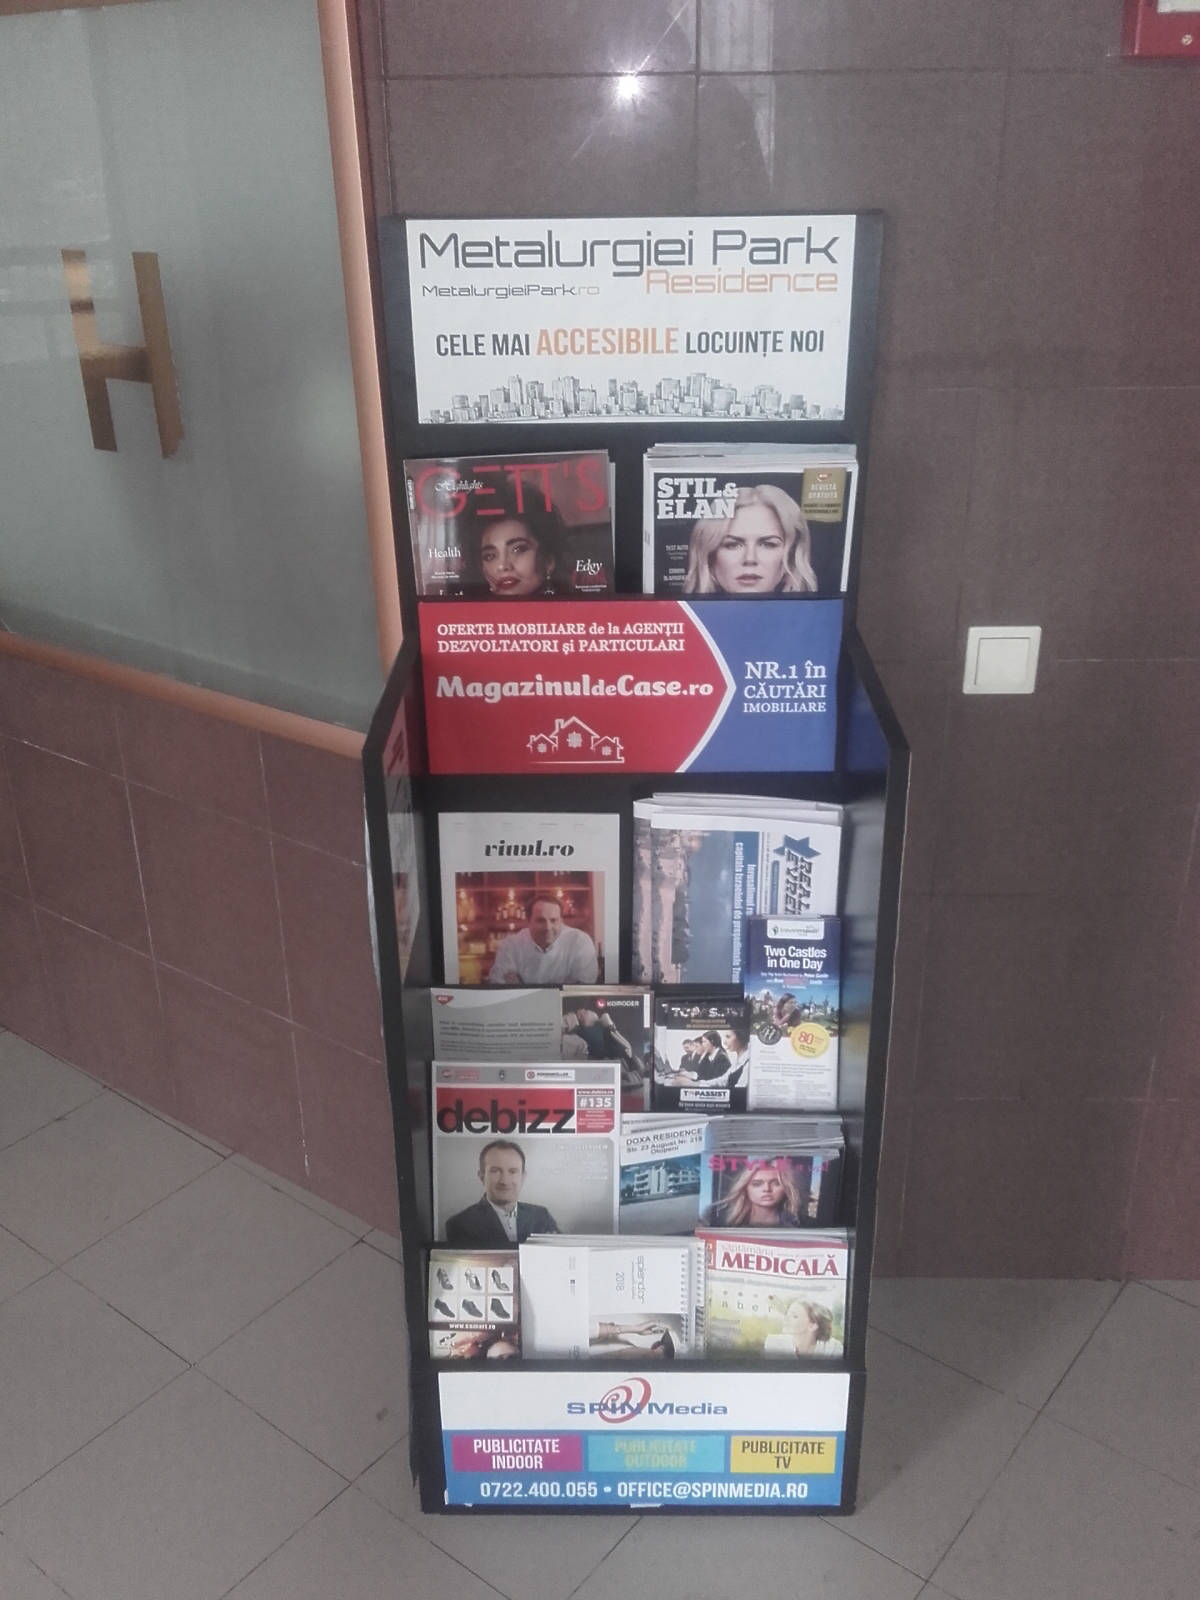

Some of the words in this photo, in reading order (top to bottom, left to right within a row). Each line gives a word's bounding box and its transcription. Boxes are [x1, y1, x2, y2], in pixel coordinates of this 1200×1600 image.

[418, 229, 694, 277] Metalurgiei
[711, 226, 840, 265] Park
[645, 267, 839, 295] Residence
[422, 283, 600, 299] MetalurgieiPark.ro
[435, 334, 486, 357] CELE
[491, 333, 531, 356] MAI
[535, 327, 679, 356] ACCESIBILE
[685, 329, 784, 357] LOCUINȚE
[790, 329, 825, 352] NOI
[416, 458, 605, 518] GETT'S
[656, 499, 737, 519] ELAN
[428, 546, 461, 559] Health
[575, 558, 603, 575] Edgy
[437, 623, 495, 635] OFERTE
[498, 623, 586, 635] IMOBILIARE
[589, 622, 605, 635] de
[608, 622, 620, 635] la
[437, 640, 559, 652] DEZVOLTATORI
[578, 639, 685, 652] PARTICULARI
[744, 661, 798, 679] NR.1
[805, 660, 826, 678] în
[436, 674, 713, 703] MagazinuldeCase.ro
[744, 681, 826, 699] CĂUTĂRI
[744, 702, 827, 712] IMOBILIARE
[764, 945, 786, 957] Two
[788, 946, 827, 958] Castles
[767, 957, 778, 968] in
[780, 958, 800, 969] One
[803, 959, 824, 971] Day
[798, 1031, 814, 1045] 80
[580, 1097, 612, 1108] #135
[436, 1099, 575, 1133] debizz
[626, 1134, 651, 1146] DOXA
[652, 1128, 703, 1141] RESIDENCE
[650, 1139, 676, 1150] August
[721, 1252, 839, 1276] MEDICALĂ
[648, 1402, 728, 1415] Media
[473, 1439, 560, 1454] PUBLICITATE
[741, 1441, 825, 1455] PUBLICITATE
[491, 1455, 543, 1469] INDOOR
[774, 1455, 792, 1469] TV
[480, 1481, 598, 1498] 0722.400.055
[617, 1482, 809, 1498] OFFICE@SPINMEDIA.RO
